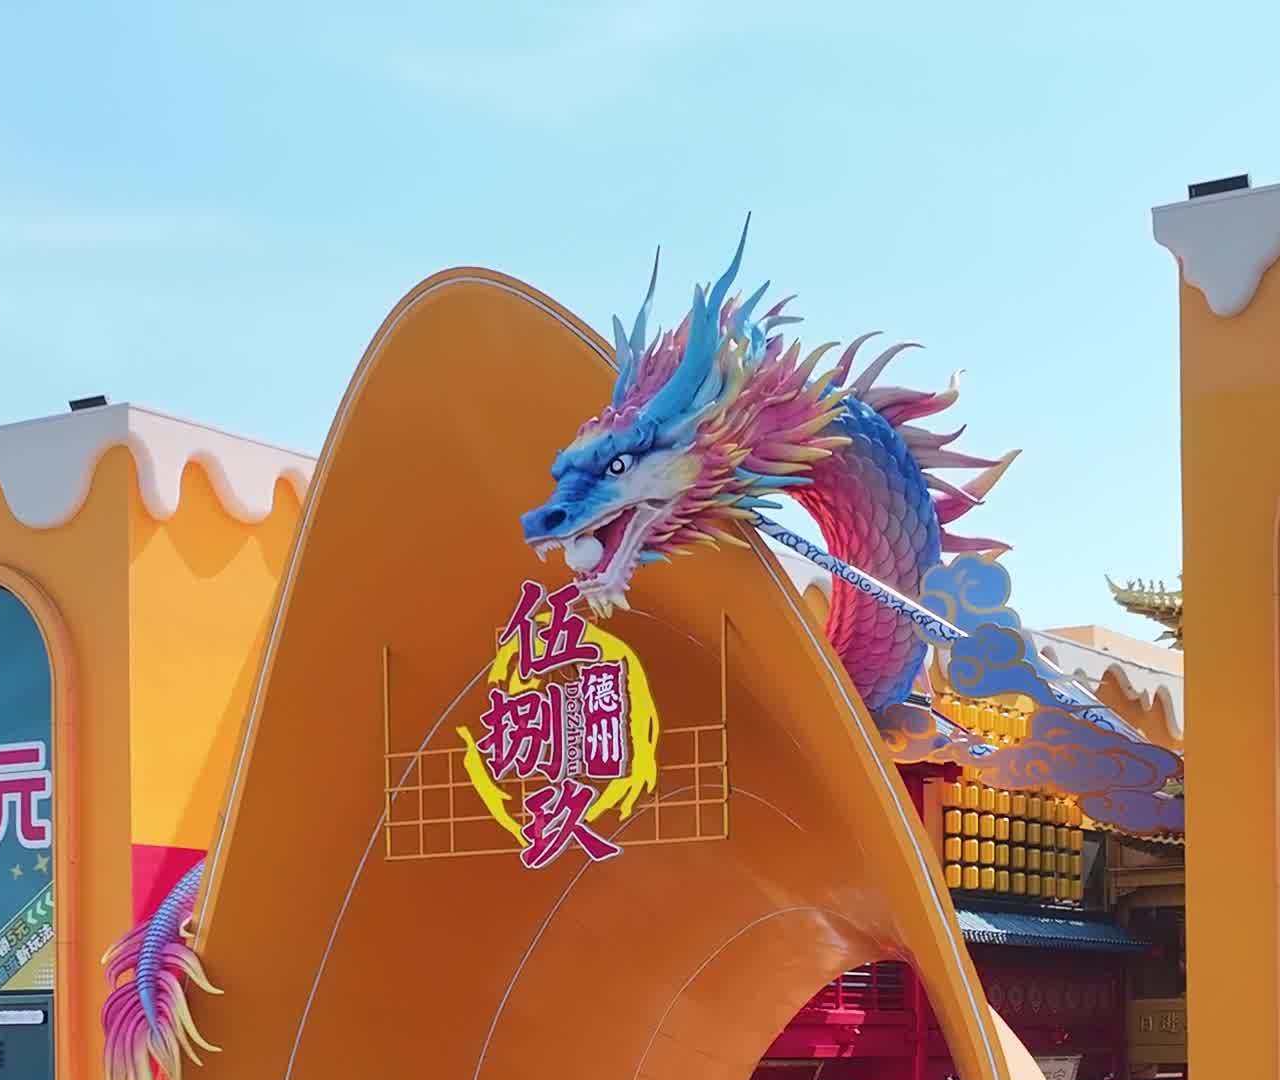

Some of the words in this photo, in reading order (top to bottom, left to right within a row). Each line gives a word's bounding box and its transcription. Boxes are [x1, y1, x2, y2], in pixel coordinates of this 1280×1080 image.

[478, 580, 618, 868] 伍捌玖
[585, 673, 620, 763] 德州
